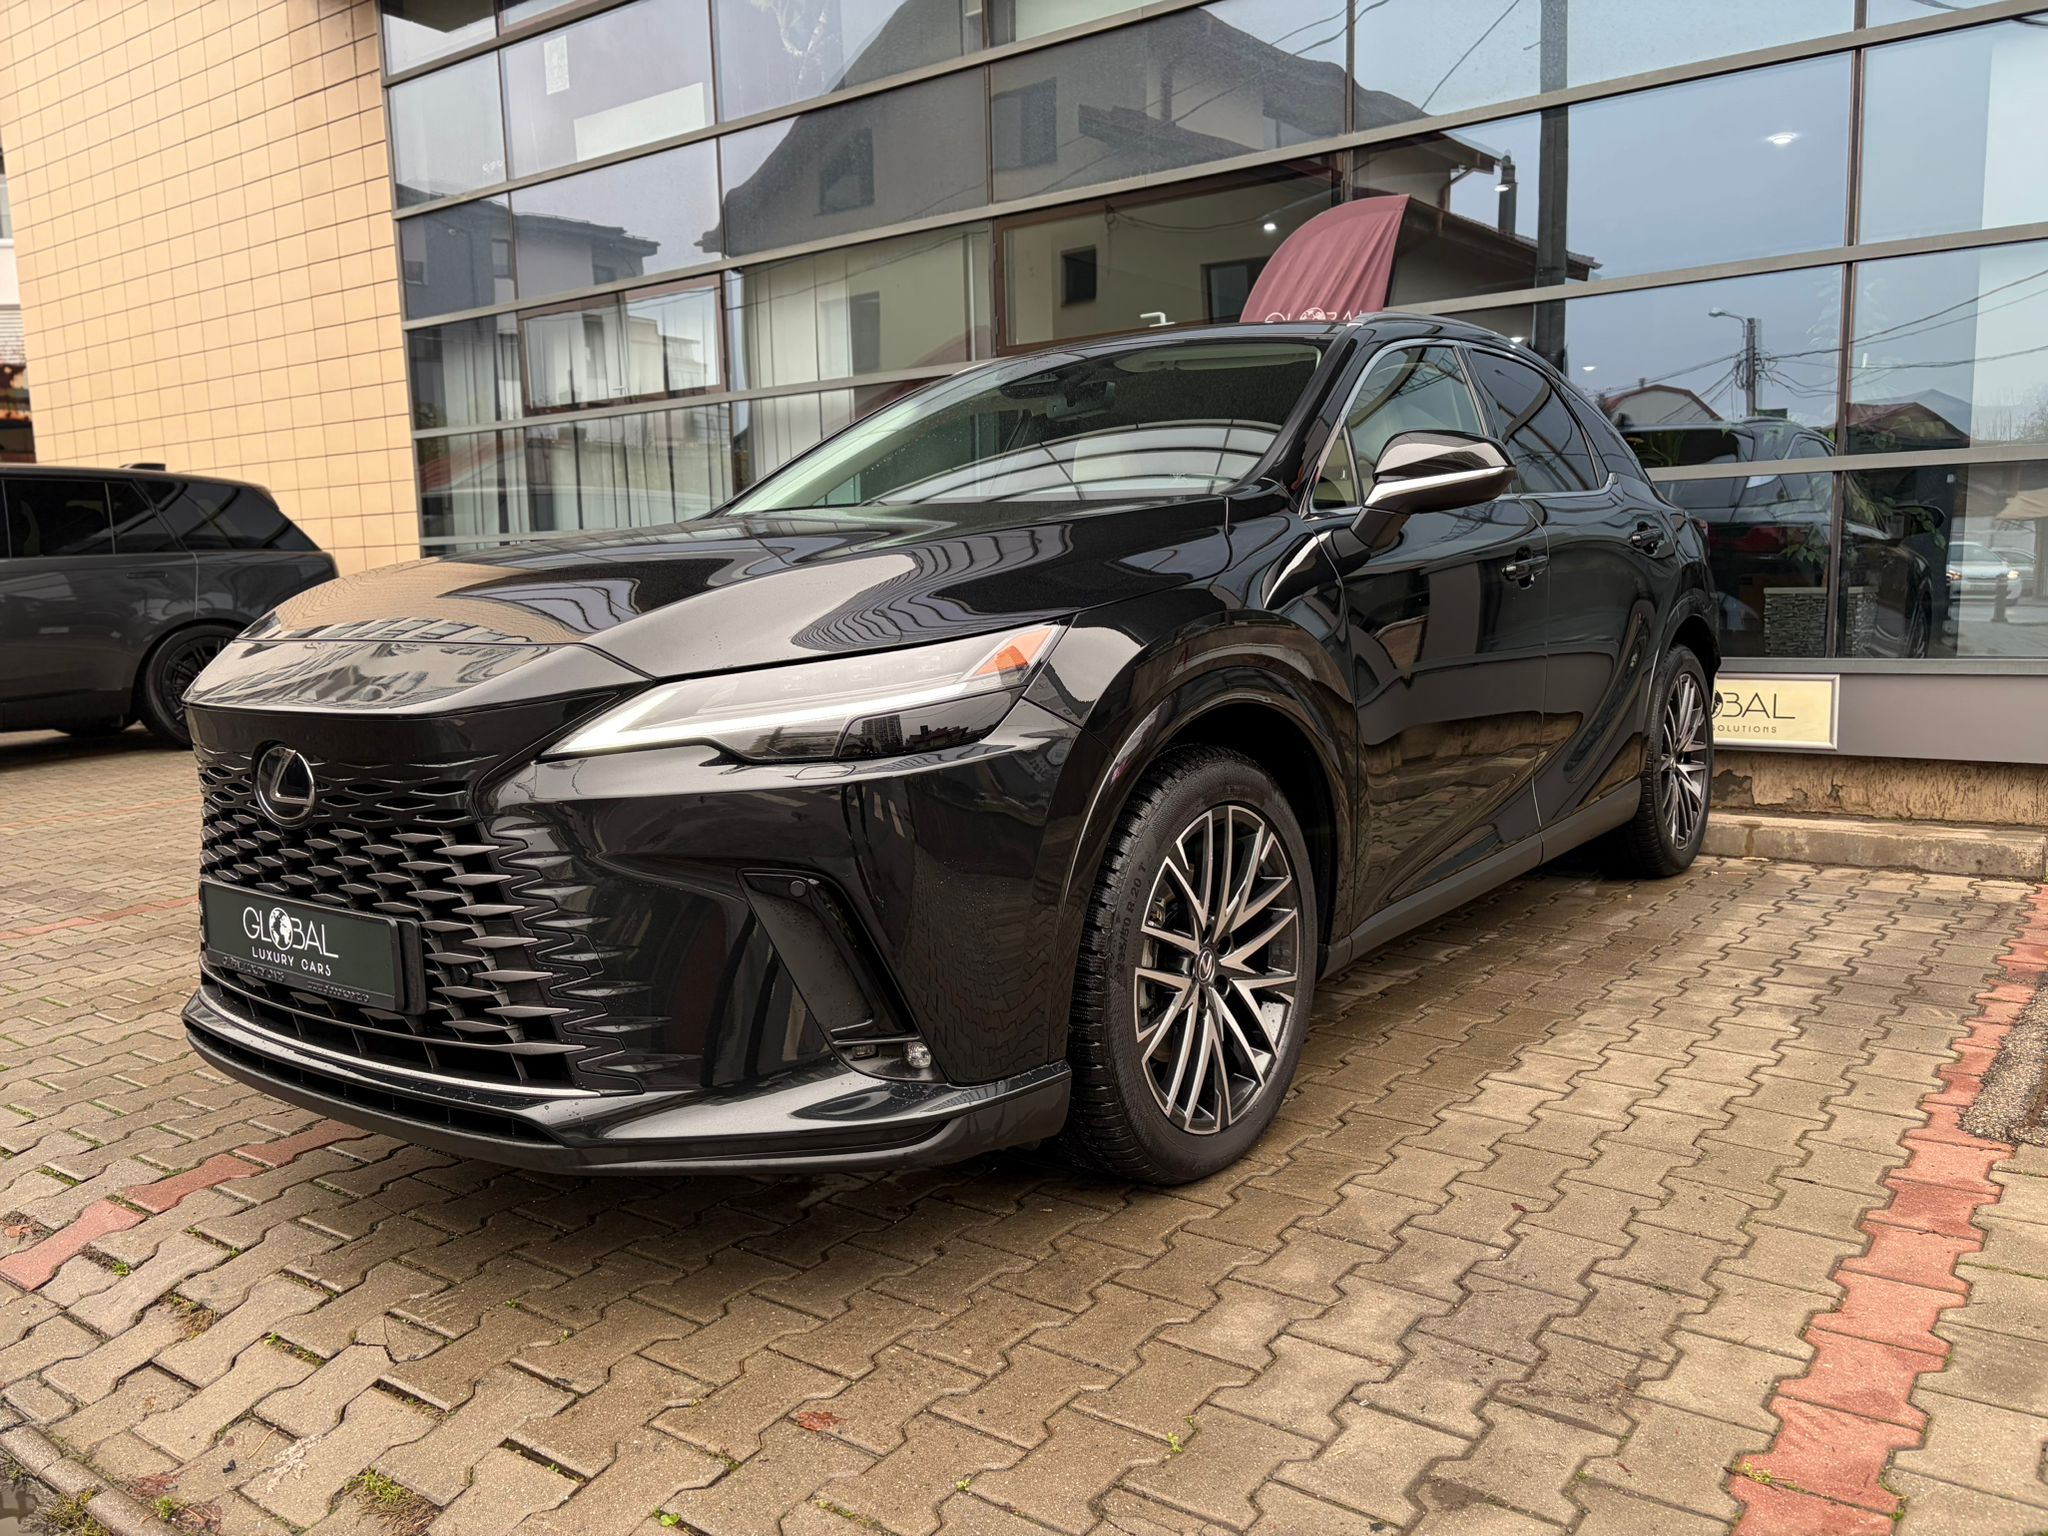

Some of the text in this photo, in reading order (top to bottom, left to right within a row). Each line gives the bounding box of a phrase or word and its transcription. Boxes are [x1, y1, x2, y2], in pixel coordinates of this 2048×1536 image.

[242, 906, 339, 959] GLOBAL
[251, 946, 295, 967] LUXURY
[301, 958, 332, 977] CARS
